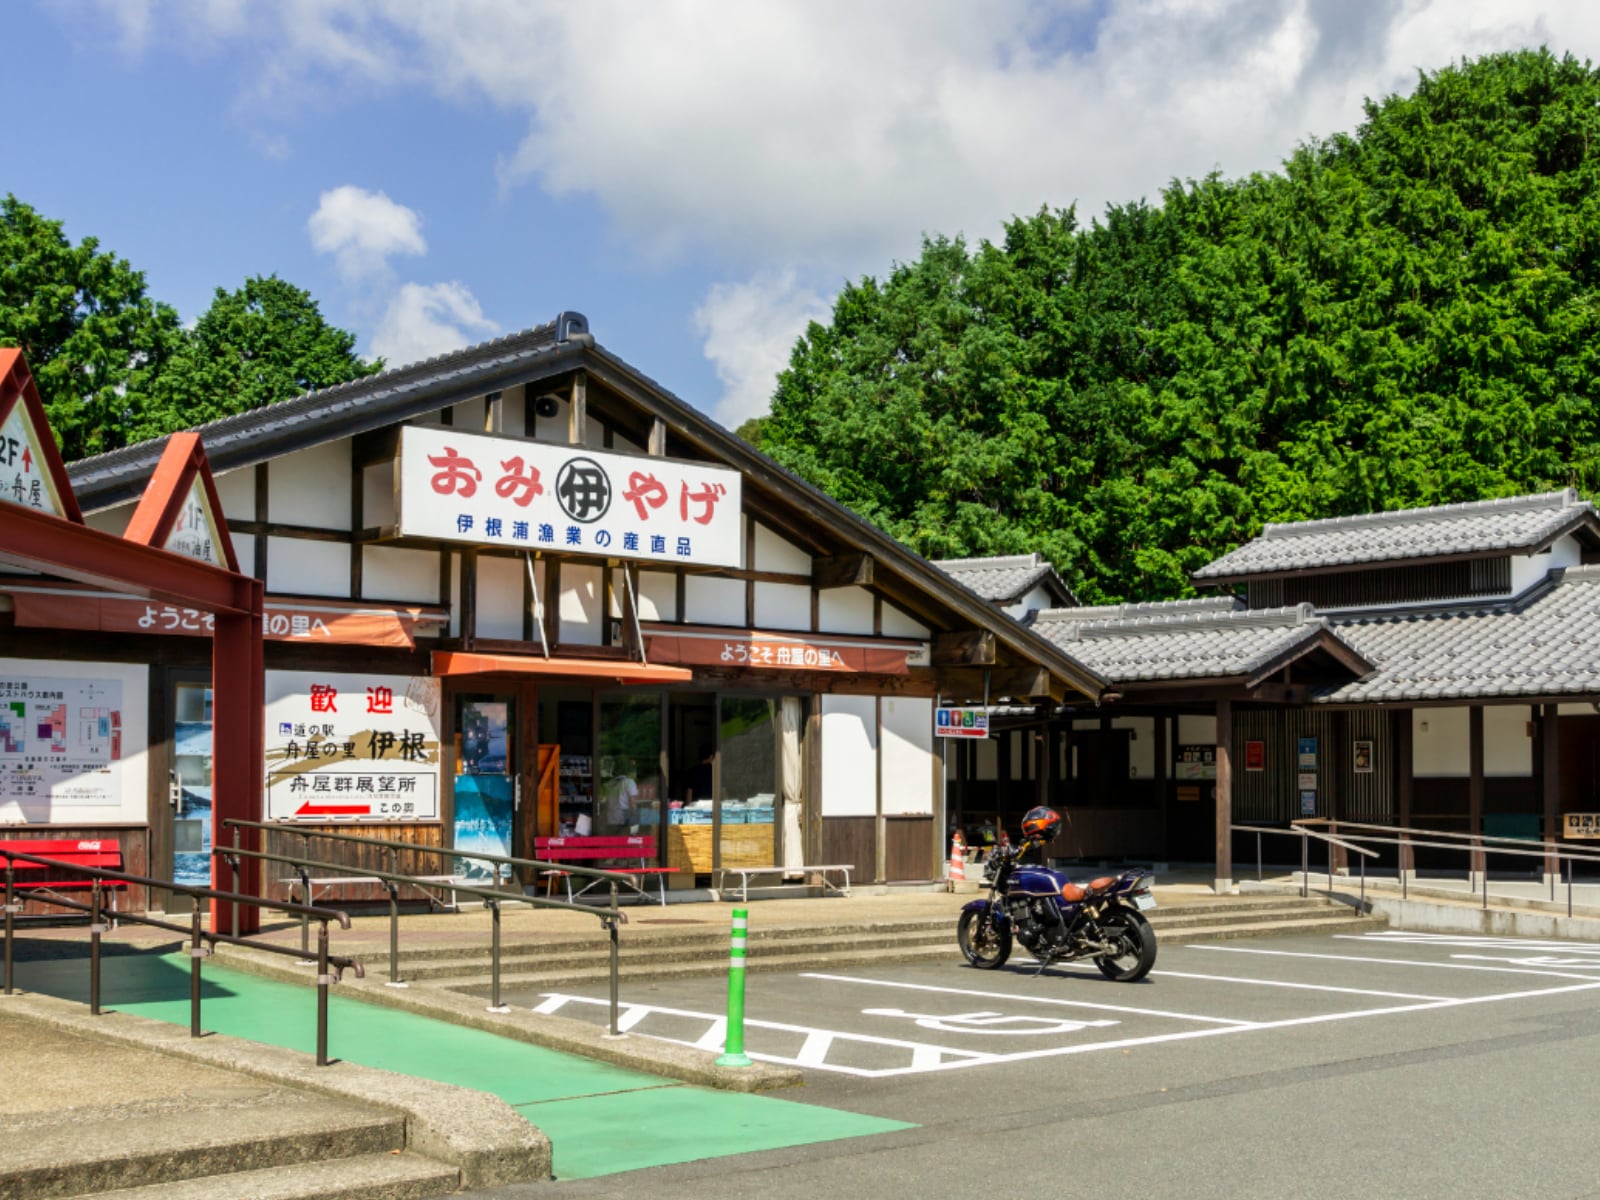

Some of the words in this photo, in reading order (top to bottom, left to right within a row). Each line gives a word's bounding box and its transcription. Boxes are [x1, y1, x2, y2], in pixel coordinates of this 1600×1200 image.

[456, 514, 692, 557] 伊根浦漁業の産直品
[310, 684, 393, 714] 歓迎
[294, 722, 335, 738] 道の駅
[290, 775, 416, 793] 舟屋群展望所
